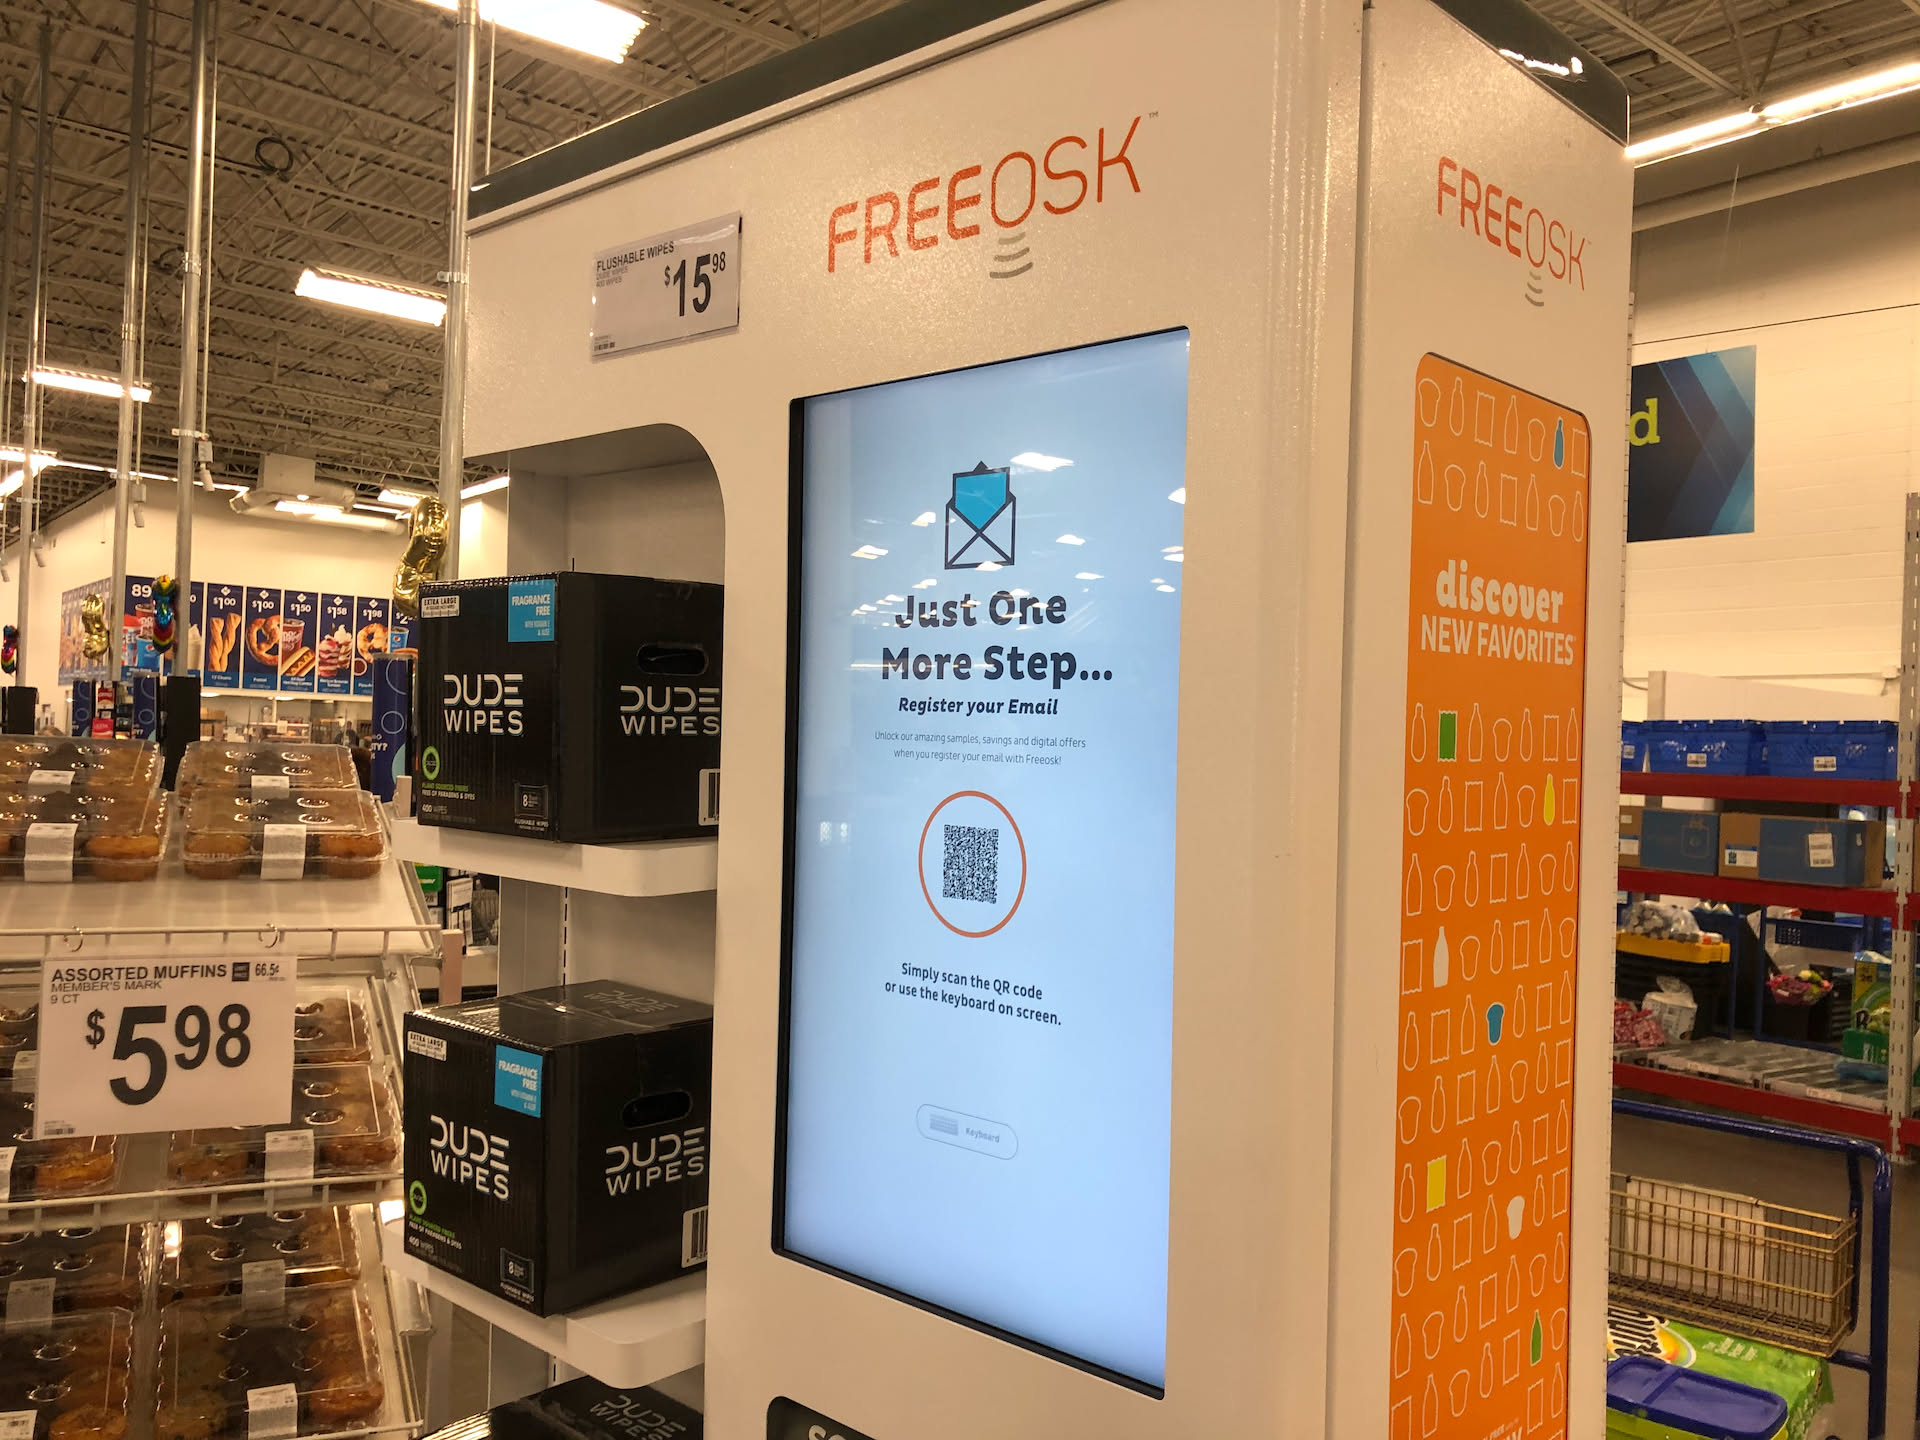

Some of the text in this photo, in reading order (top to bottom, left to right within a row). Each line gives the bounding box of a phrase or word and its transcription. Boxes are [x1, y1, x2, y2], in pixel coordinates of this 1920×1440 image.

[827, 115, 1142, 273] FREEOSK
[1437, 156, 1586, 291] FREEOSK
[596, 240, 675, 272] FLUSHABLE WIPES
[424, 597, 457, 606] EXTRA LARGE
[511, 594, 551, 606] FRAGRANCE
[1436, 559, 1564, 623] discover
[535, 605, 551, 616] FREE
[895, 590, 1067, 629] Just One
[1421, 614, 1575, 666] NEW FAVORITES
[882, 645, 1113, 690] More Step...
[443, 673, 524, 707] DUDE
[620, 684, 720, 713] DUDE
[898, 697, 1059, 717] Register your Email
[443, 709, 524, 737] WIPES
[620, 715, 720, 736] WIPES
[874, 731, 900, 741] Unlock
[914, 733, 946, 744] amazing
[946, 734, 981, 745] samples,
[982, 736, 1012, 747] savings
[1013, 736, 1029, 746] and
[1030, 736, 1058, 749] digital
[1059, 736, 1087, 748] offers
[893, 749, 1062, 766] when you register your email with Freeosk!
[422, 803, 433, 813] 400
[522, 794, 528, 807] 8
[51, 966, 148, 982] ASSORTED
[153, 964, 227, 979] MUFFINS
[51, 980, 162, 993] MEMBER'S MARK
[901, 962, 1043, 1000] Simply scan the QR code
[51, 993, 80, 1004] 9 CT
[885, 981, 1062, 1026] or use the keyboard on screen.
[410, 1033, 444, 1048] EXTRA LARGE
[498, 1059, 538, 1080] FRAGRANCE
[522, 1078, 537, 1092] FREE
[430, 1114, 510, 1173] DUDE
[965, 1127, 1001, 1144] Keyboard
[605, 1127, 705, 1175] DUDE
[430, 1149, 510, 1200] WIPES
[605, 1154, 705, 1197] WIPES
[604, 1394, 686, 1438] DUDE
